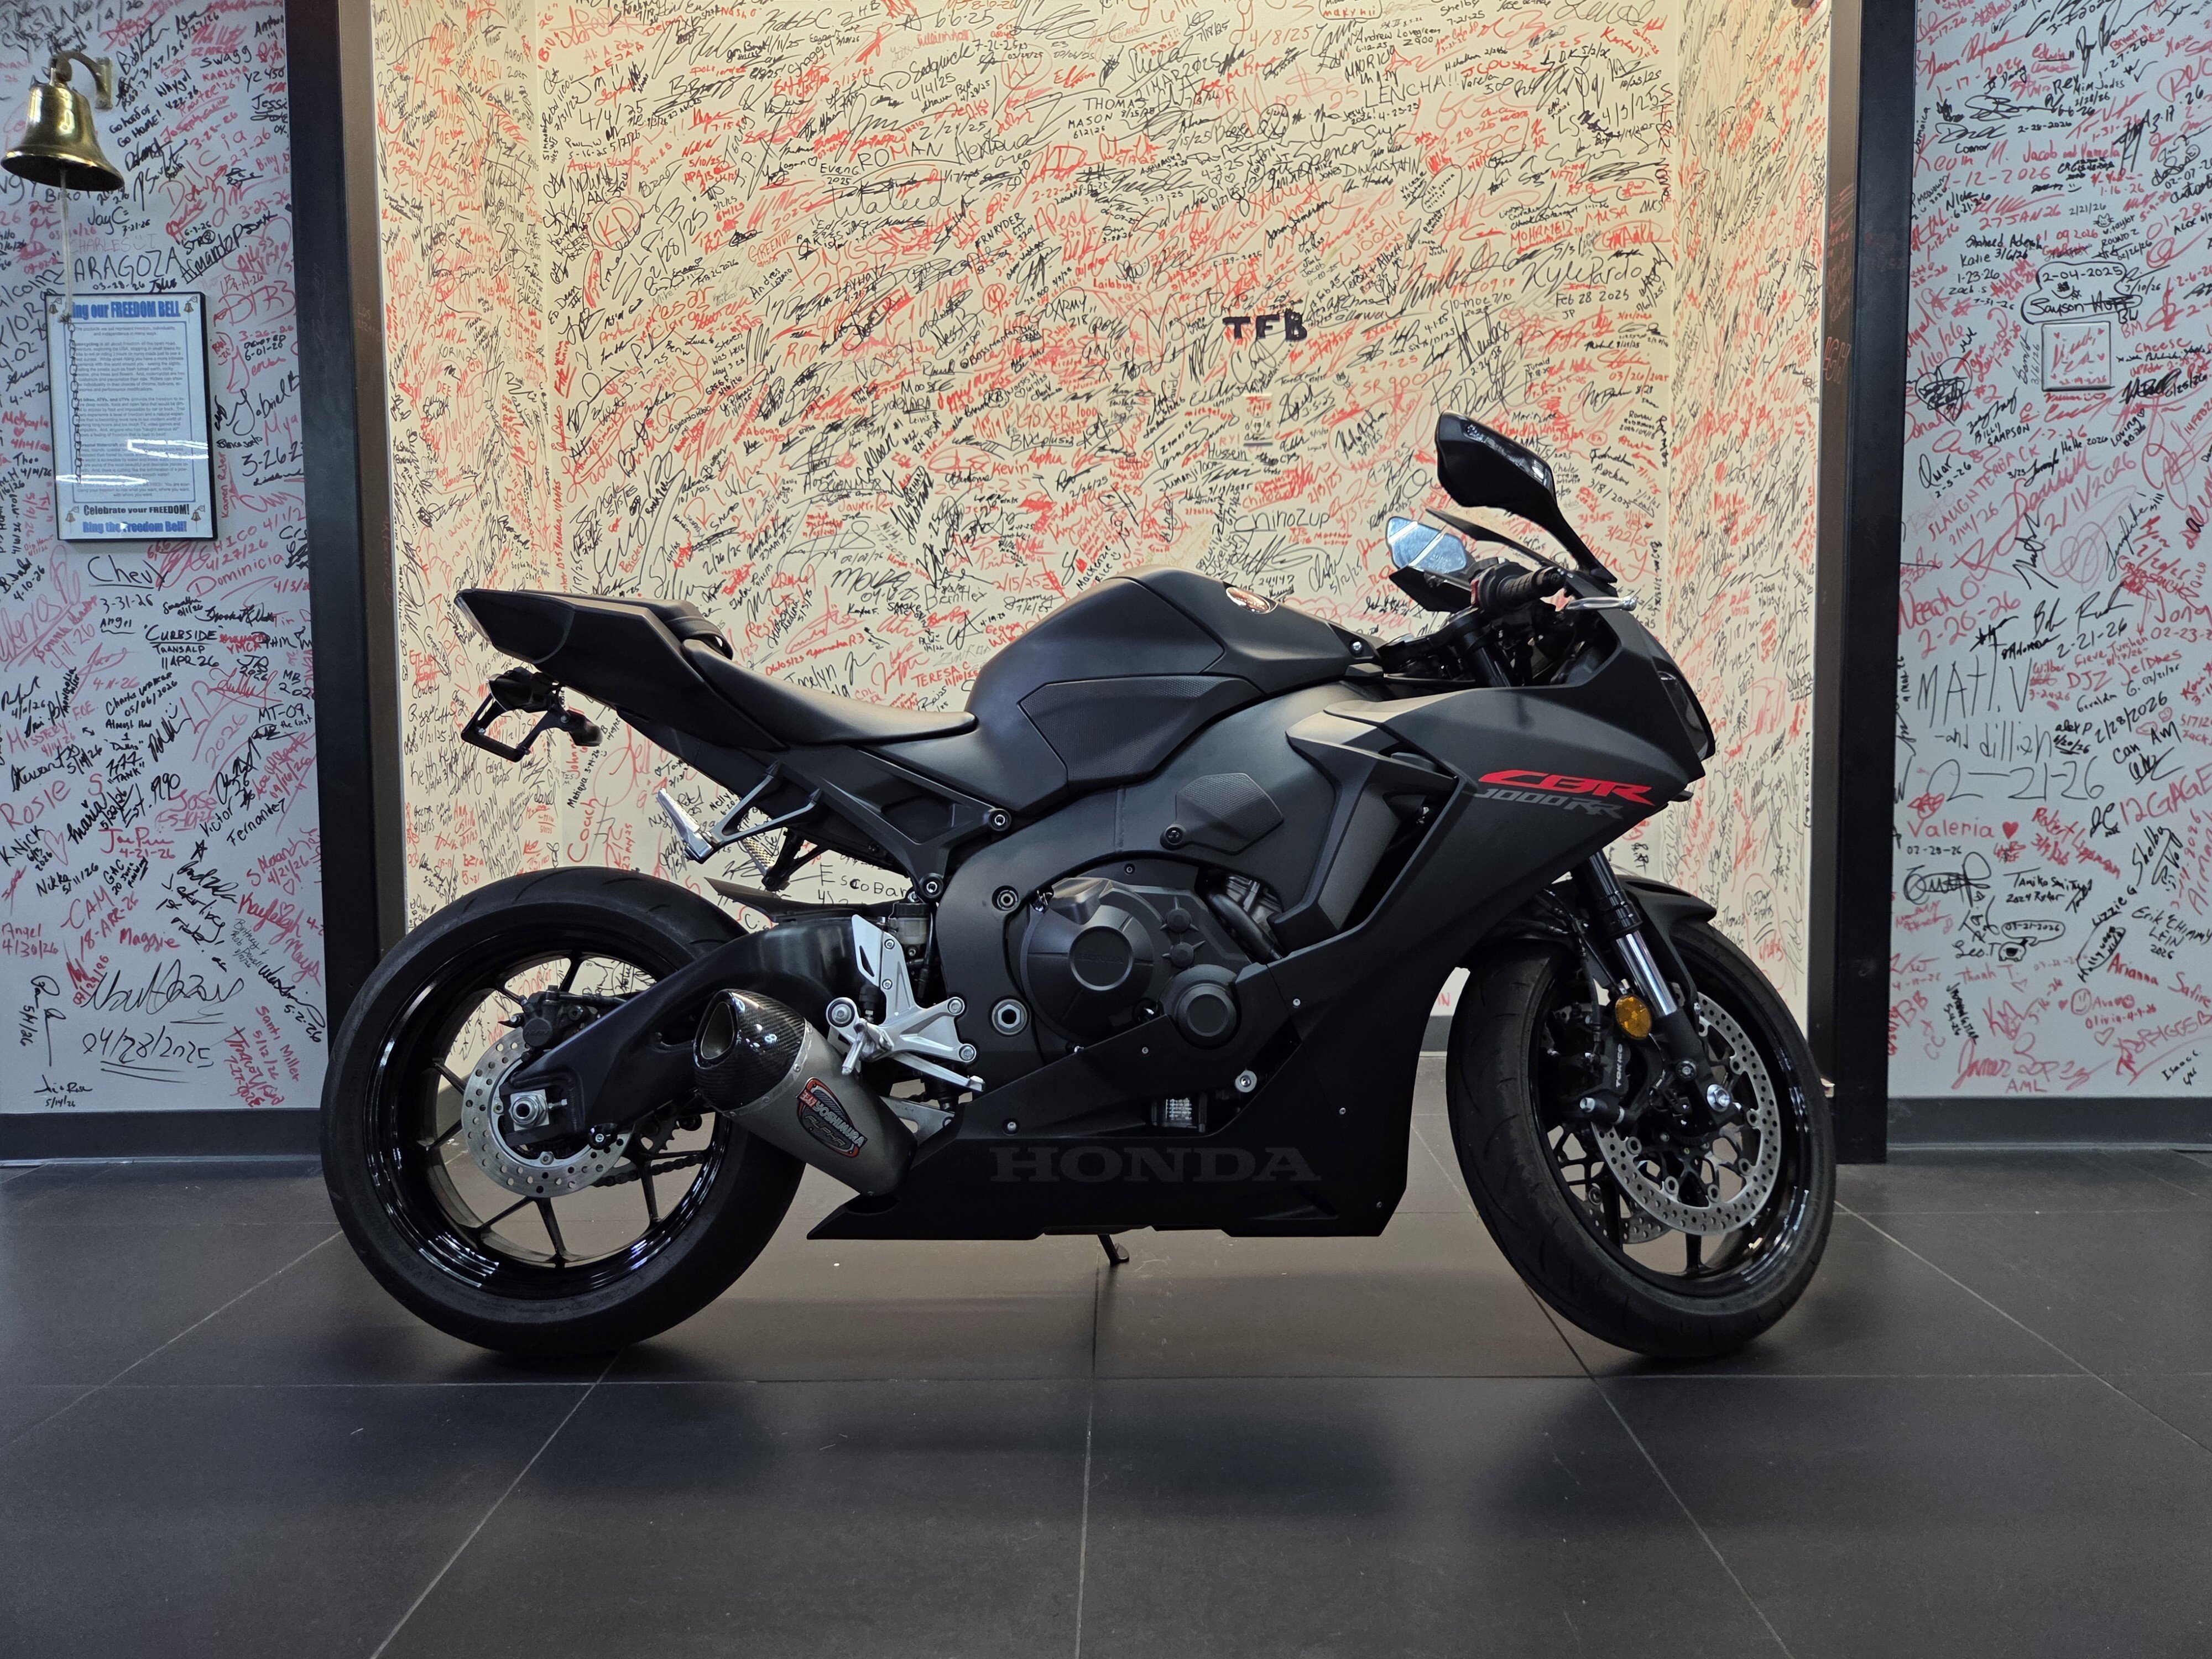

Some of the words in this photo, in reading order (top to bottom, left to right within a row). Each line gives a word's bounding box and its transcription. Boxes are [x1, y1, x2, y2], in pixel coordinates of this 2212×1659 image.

[72, 302, 88, 320] ing
[91, 304, 109, 318] our
[111, 301, 156, 318] FREEDOM
[158, 301, 181, 317] BELL
[1222, 307, 1307, 343] TFB
[84, 505, 126, 515] Celebrate
[128, 507, 147, 517] your
[149, 504, 189, 515] FREEDOM!
[83, 521, 104, 534] Ring
[165, 521, 187, 532] Bell!
[1479, 770, 1655, 806] CBR
[1475, 789, 1623, 819] 1000RR
[805, 1115, 846, 1146] ALPHA
[812, 1100, 864, 1147] YOSHIMURA
[989, 1146, 1322, 1182] HONDA
